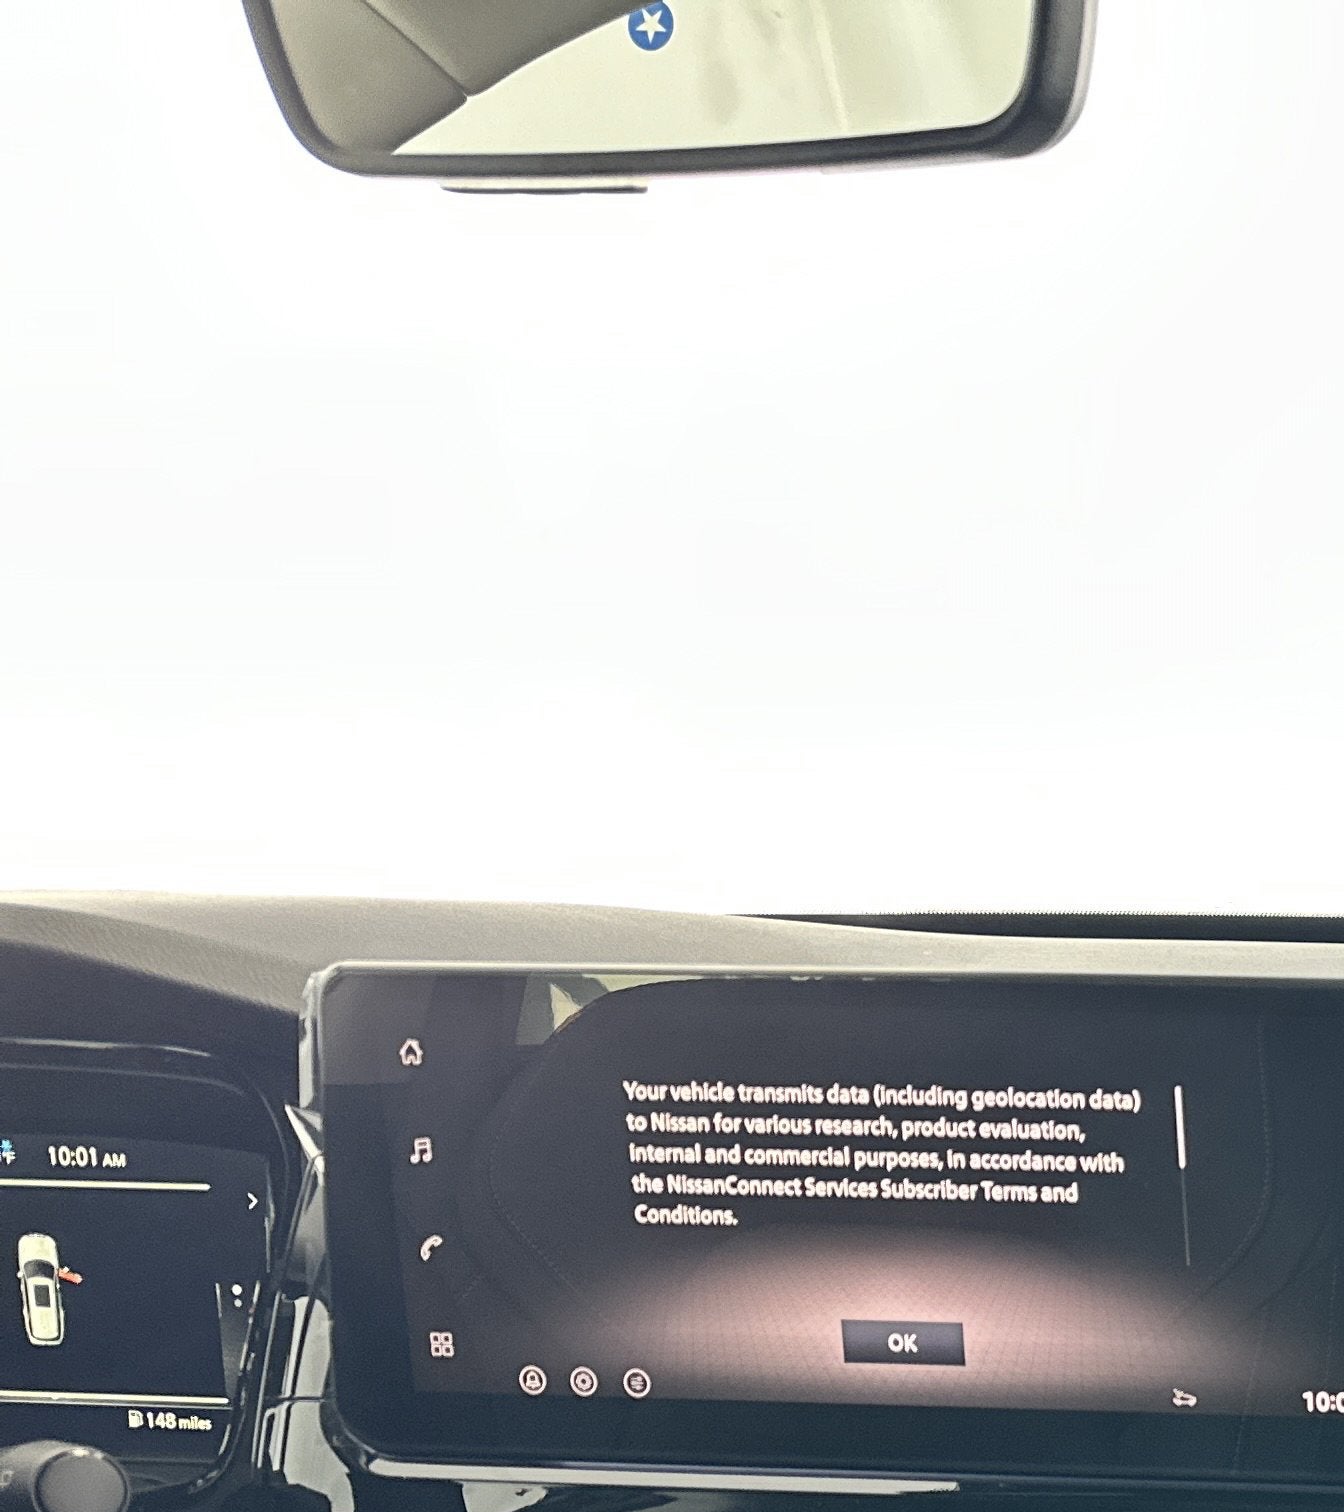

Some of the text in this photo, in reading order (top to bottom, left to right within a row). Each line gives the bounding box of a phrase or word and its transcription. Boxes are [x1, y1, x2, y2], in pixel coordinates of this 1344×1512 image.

[623, 1080, 1141, 1113] Your vehicle transmits data (including geolocation data)
[626, 1113, 1085, 1144] to Nissan for various research, product evaluation,
[48, 1145, 97, 1168] 10:01
[102, 1153, 127, 1168] AM
[629, 1142, 700, 1164] internal
[705, 1144, 741, 1164] and
[745, 1146, 850, 1168] commercial
[854, 1146, 943, 1171] purposes,
[970, 1150, 1076, 1172] accordance
[1079, 1152, 1124, 1173] with
[632, 1173, 1078, 1203] the NissanConnect Services Subscriber Terms and
[634, 1204, 738, 1226] Conditions.
[887, 1332, 918, 1355] OK
[147, 1412, 212, 1431] 148 miles
